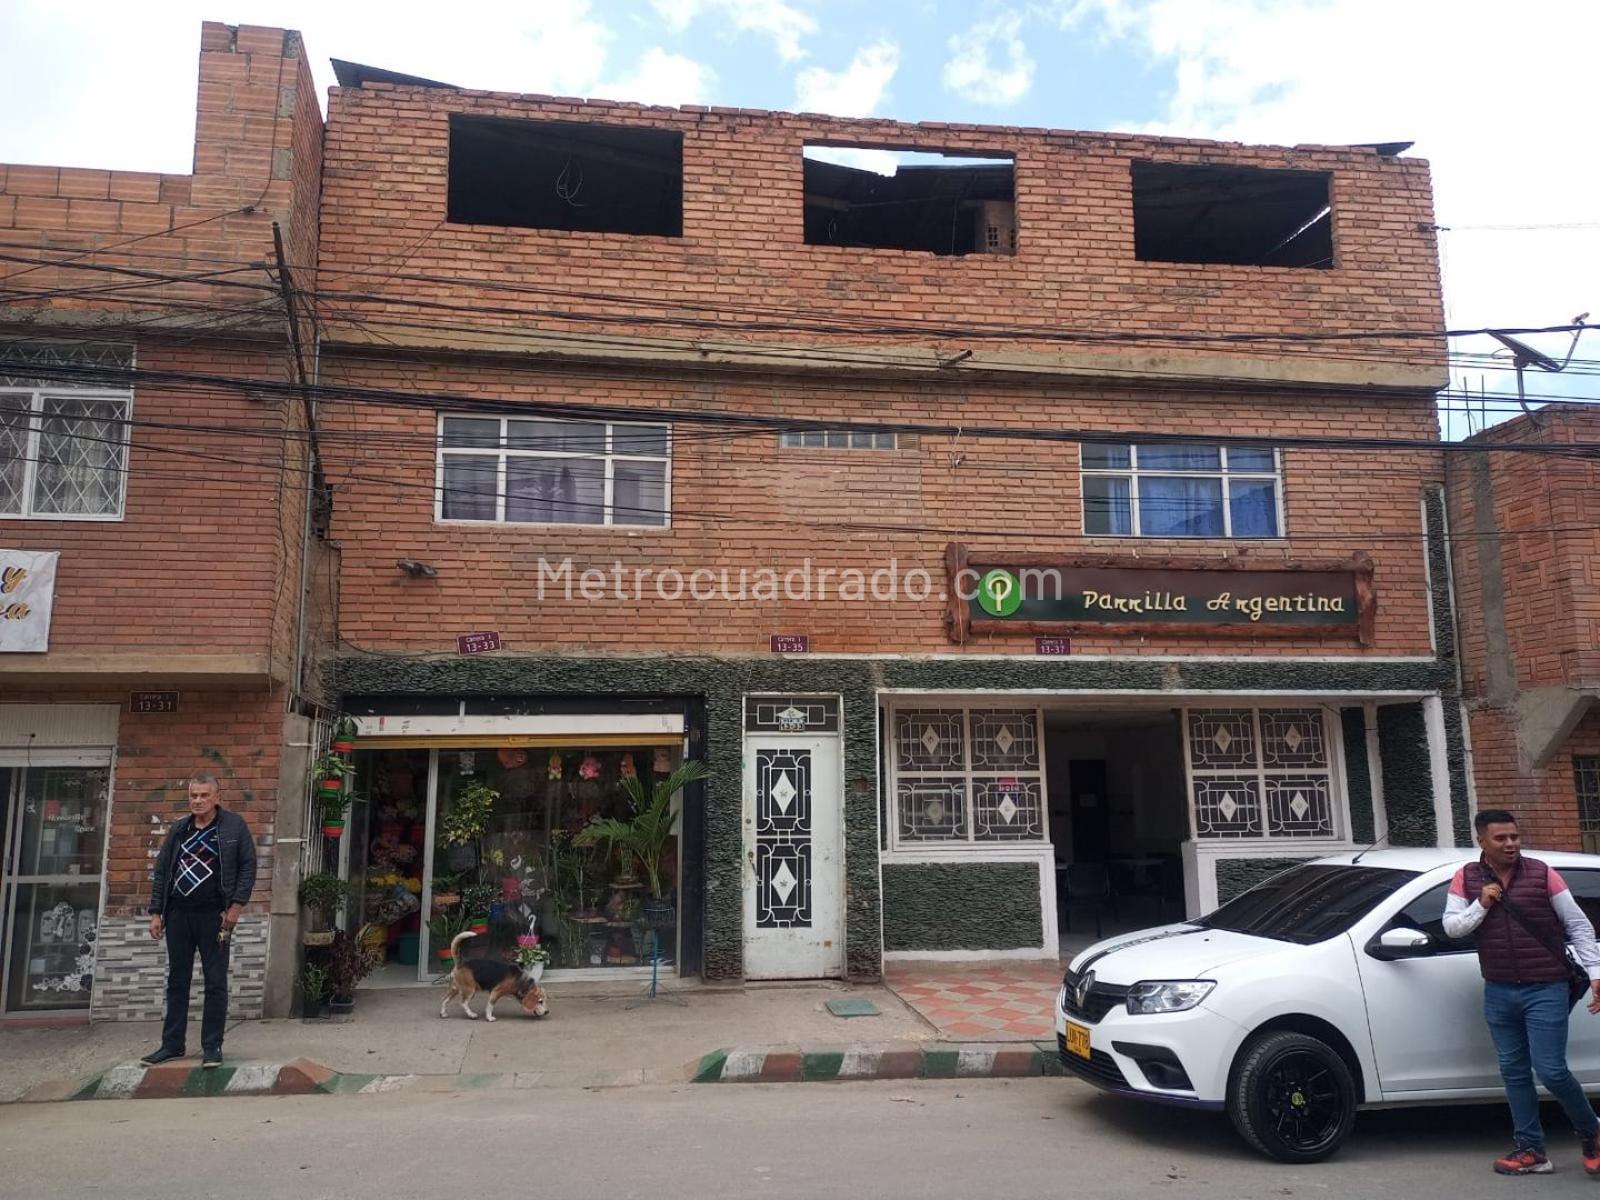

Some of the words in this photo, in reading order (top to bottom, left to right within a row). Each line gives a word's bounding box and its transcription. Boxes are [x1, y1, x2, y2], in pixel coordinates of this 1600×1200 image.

[1082, 591, 1187, 613] Parrilla
[1206, 592, 1345, 621] Argentina
[466, 640, 495, 652] 13-33
[778, 643, 803, 651] 13-35
[140, 700, 172, 710] 13-31
